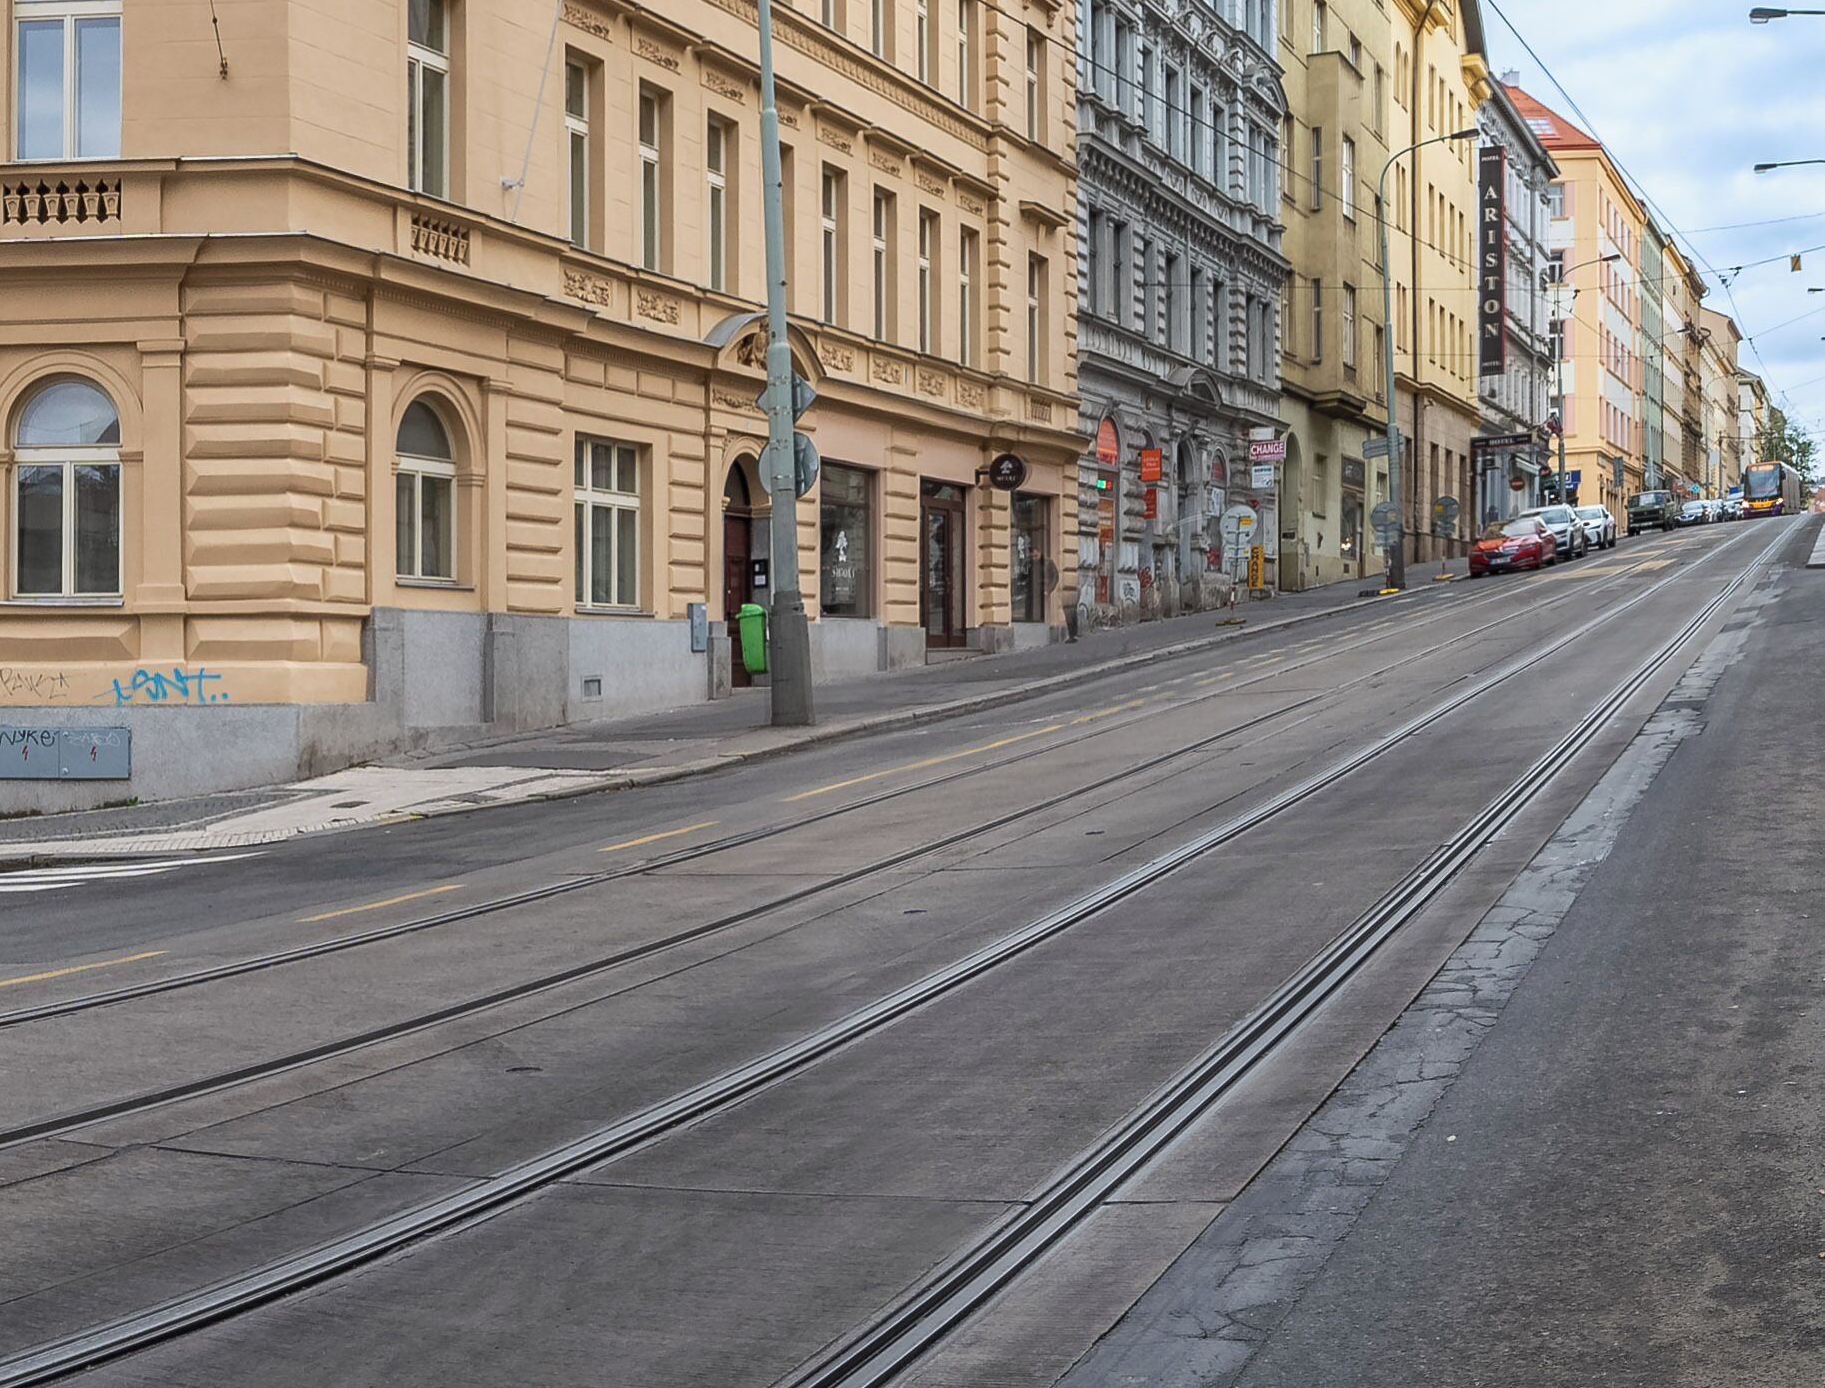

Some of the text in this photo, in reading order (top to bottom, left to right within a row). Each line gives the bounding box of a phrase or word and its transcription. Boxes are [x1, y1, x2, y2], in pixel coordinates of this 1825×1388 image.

[1483, 185, 1500, 338] ARISTON
[1489, 437, 1514, 446] HOTEL
[1251, 443, 1284, 455] CHANGE
